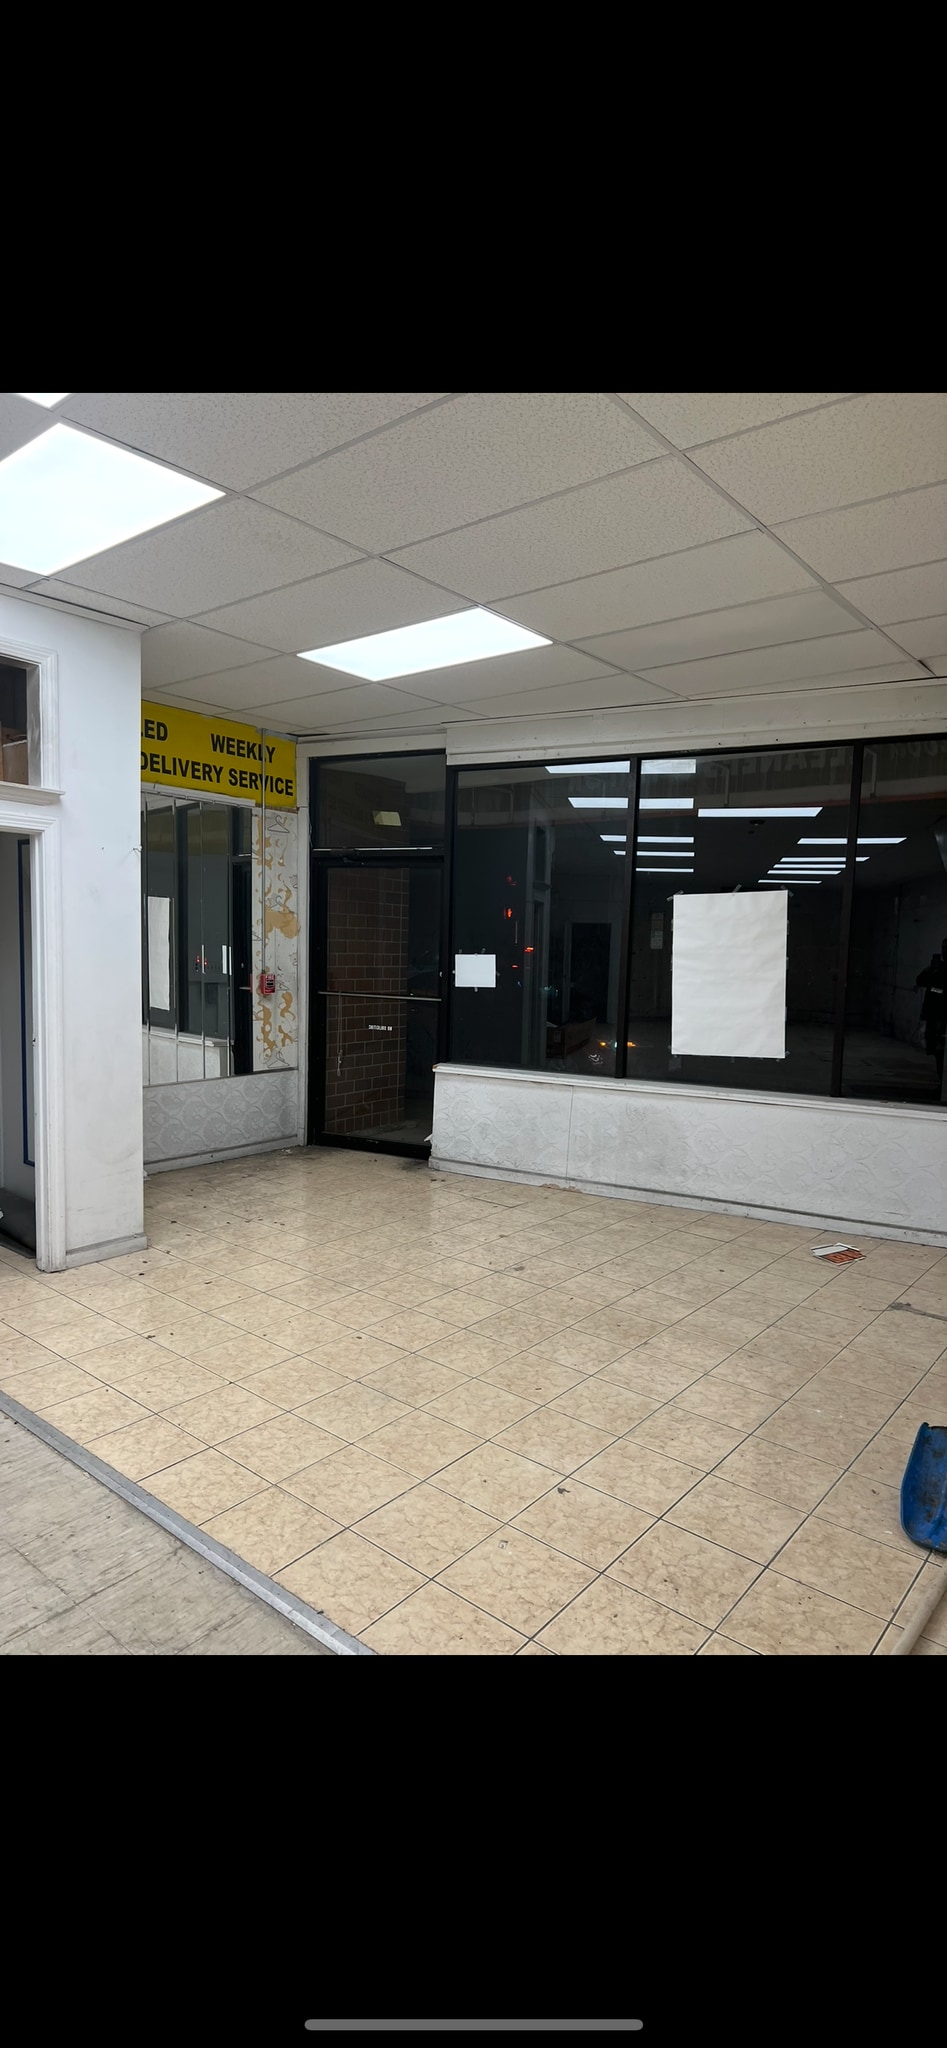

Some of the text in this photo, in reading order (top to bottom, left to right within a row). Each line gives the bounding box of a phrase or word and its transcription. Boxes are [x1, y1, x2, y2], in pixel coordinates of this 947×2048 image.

[141, 718, 275, 763] ED WEEKLY
[141, 751, 294, 797] DELIVERY SERVICE
